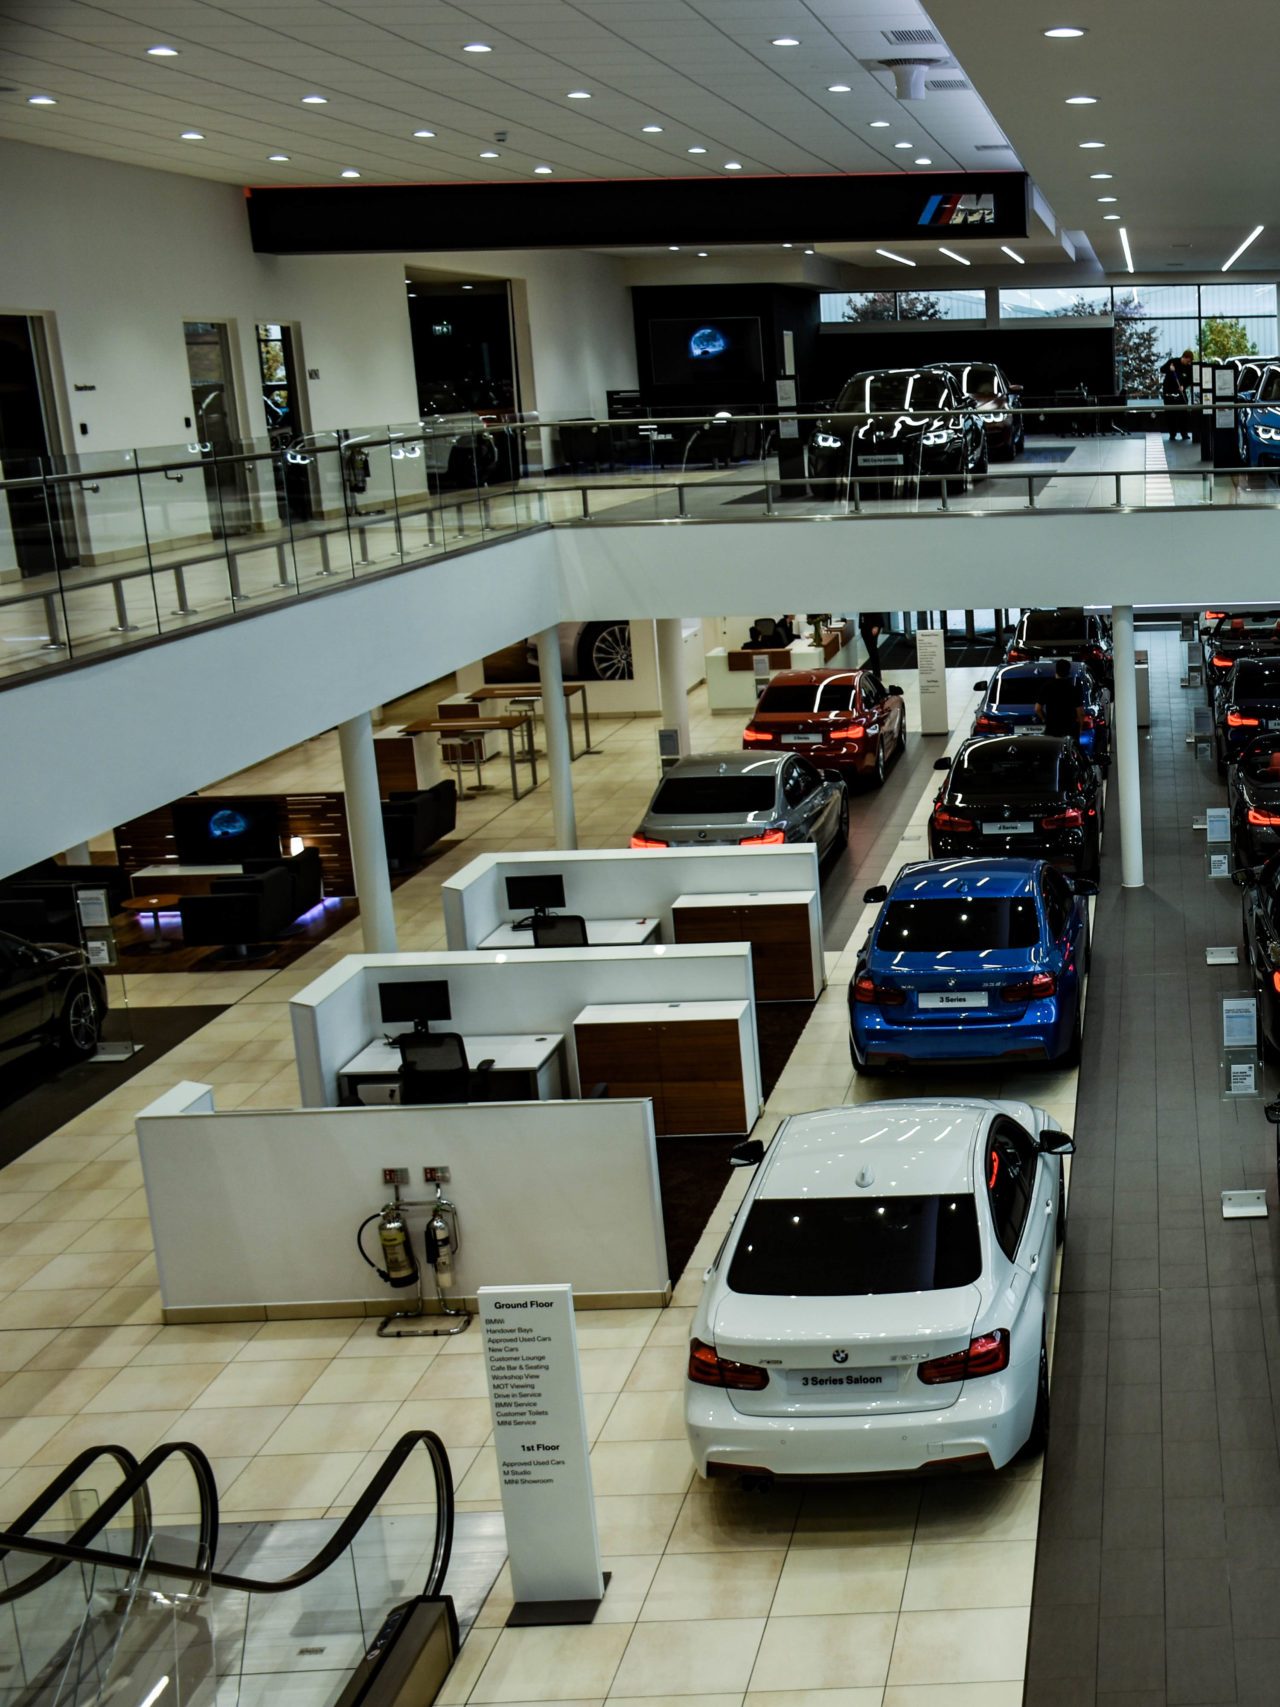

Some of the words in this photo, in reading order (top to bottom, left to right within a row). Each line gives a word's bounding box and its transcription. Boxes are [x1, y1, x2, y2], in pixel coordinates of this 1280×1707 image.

[494, 1301, 528, 1310] Ground
[530, 1300, 554, 1308] Floor
[802, 1377, 809, 1386] 3
[810, 1376, 844, 1386] Series
[846, 1375, 882, 1384] Saloon
